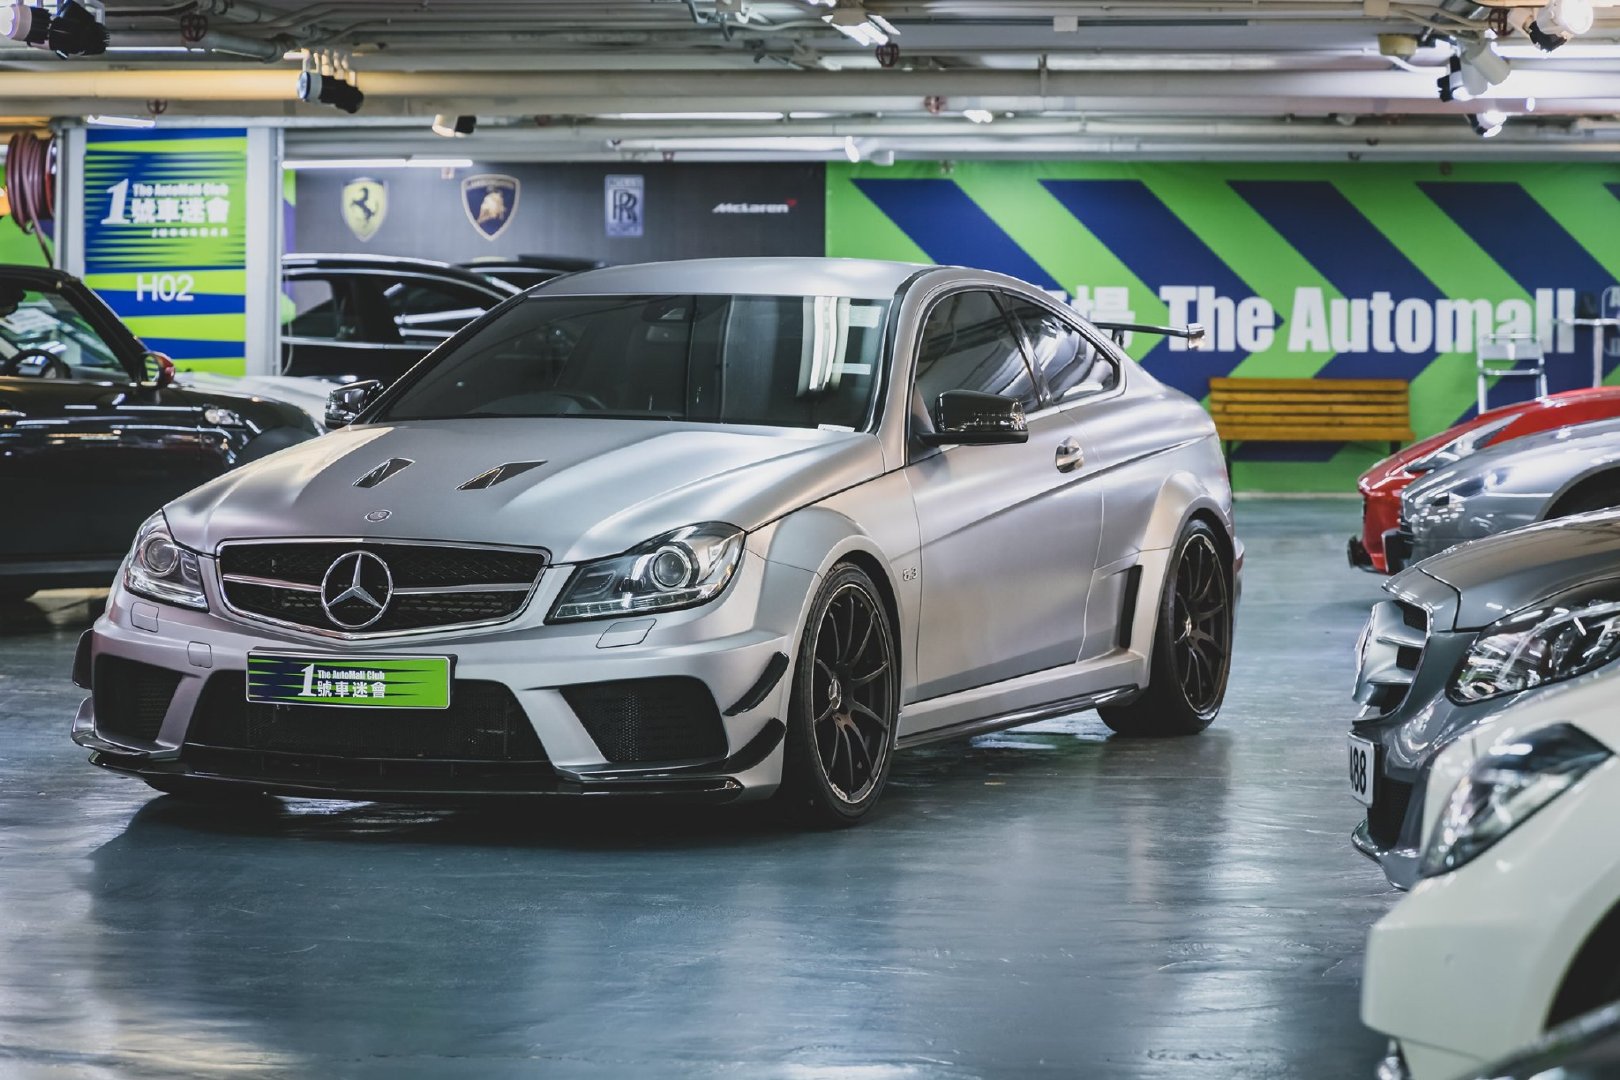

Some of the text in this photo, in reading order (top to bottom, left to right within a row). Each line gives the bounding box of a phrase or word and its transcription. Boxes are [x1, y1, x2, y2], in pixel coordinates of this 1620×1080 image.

[101, 178, 131, 225] 1
[712, 203, 789, 213] McLaren
[136, 274, 194, 302] H02
[1159, 285, 1575, 353] The Automall
[297, 663, 317, 697] 1
[317, 669, 385, 680] The AutoMall Club
[317, 680, 386, 698] 號車迷會
